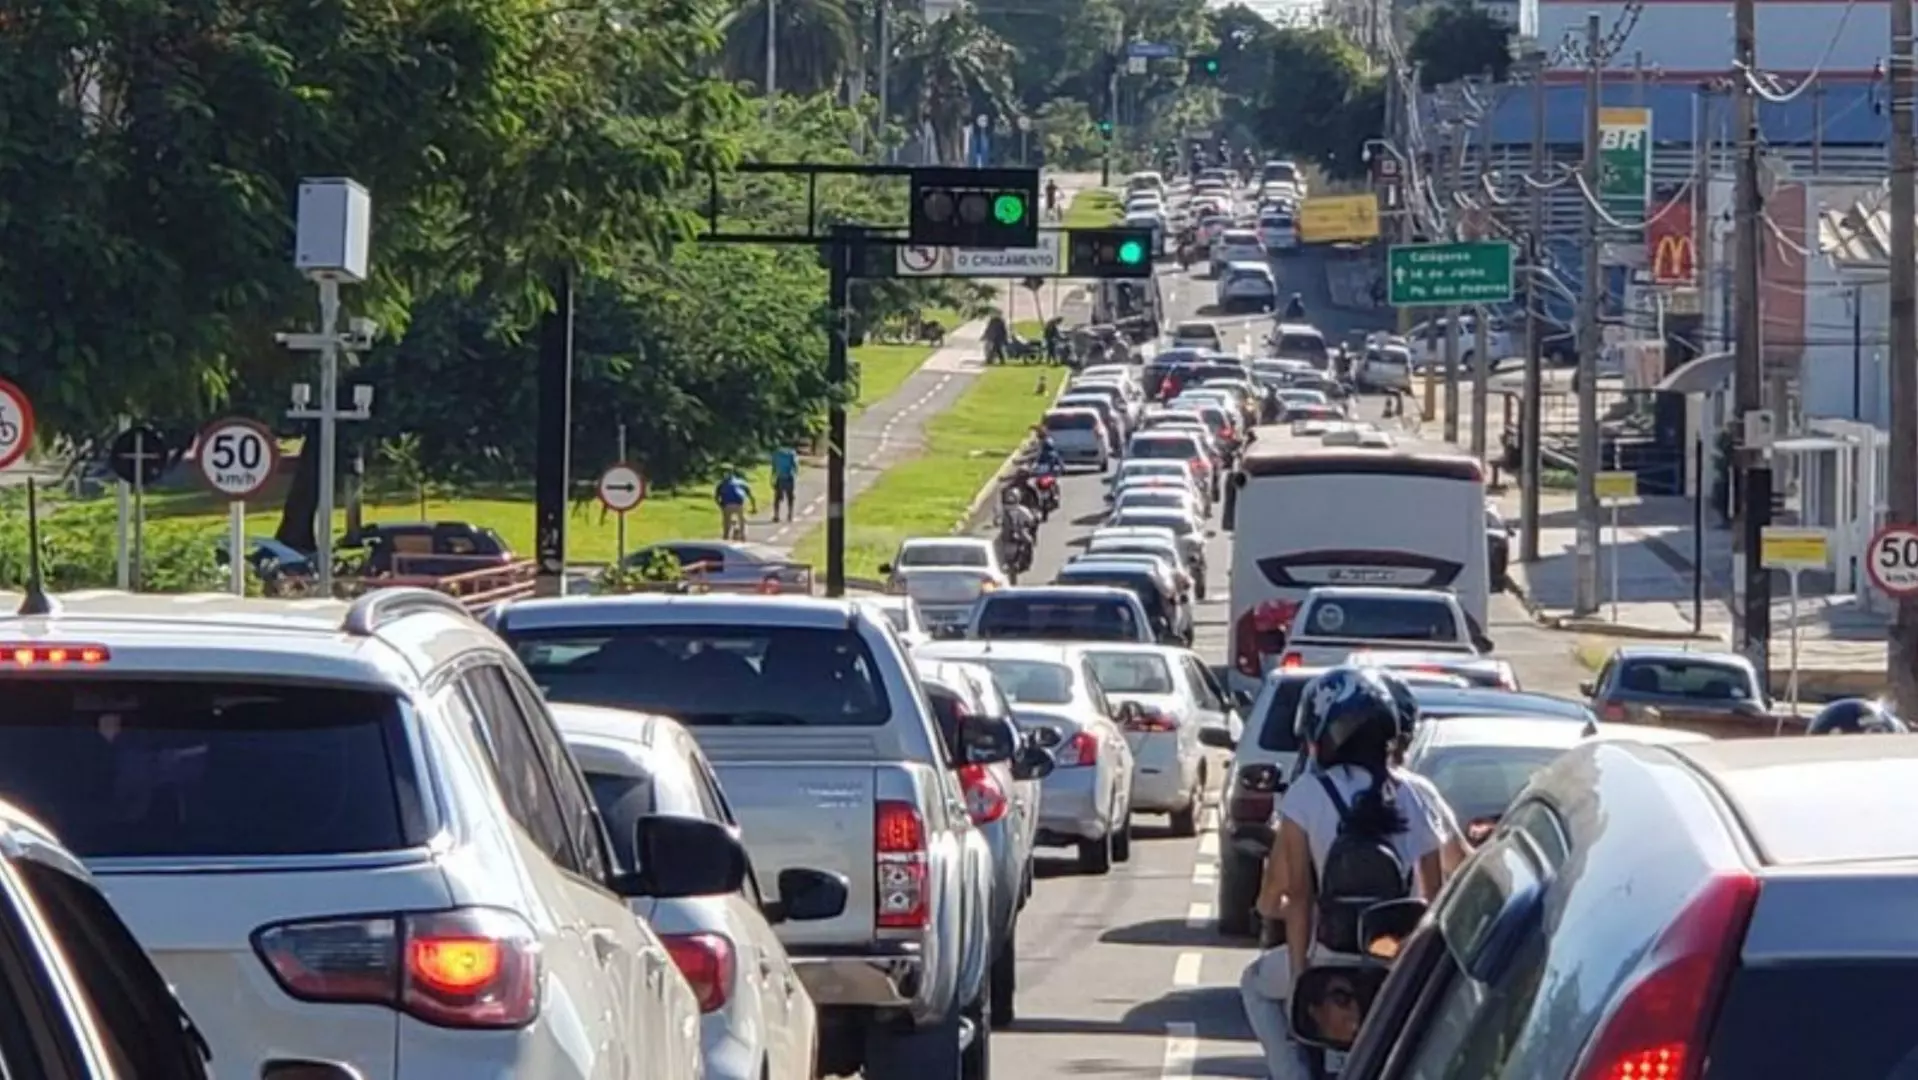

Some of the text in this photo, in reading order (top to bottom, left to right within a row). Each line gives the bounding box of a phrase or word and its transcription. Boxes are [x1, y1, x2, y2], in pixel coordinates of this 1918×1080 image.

[1601, 129, 1641, 150] BR
[972, 253, 1054, 267] CRUZAMENTO
[212, 434, 261, 469] 50
[216, 472, 257, 485] km/h
[1880, 537, 1918, 568] 50
